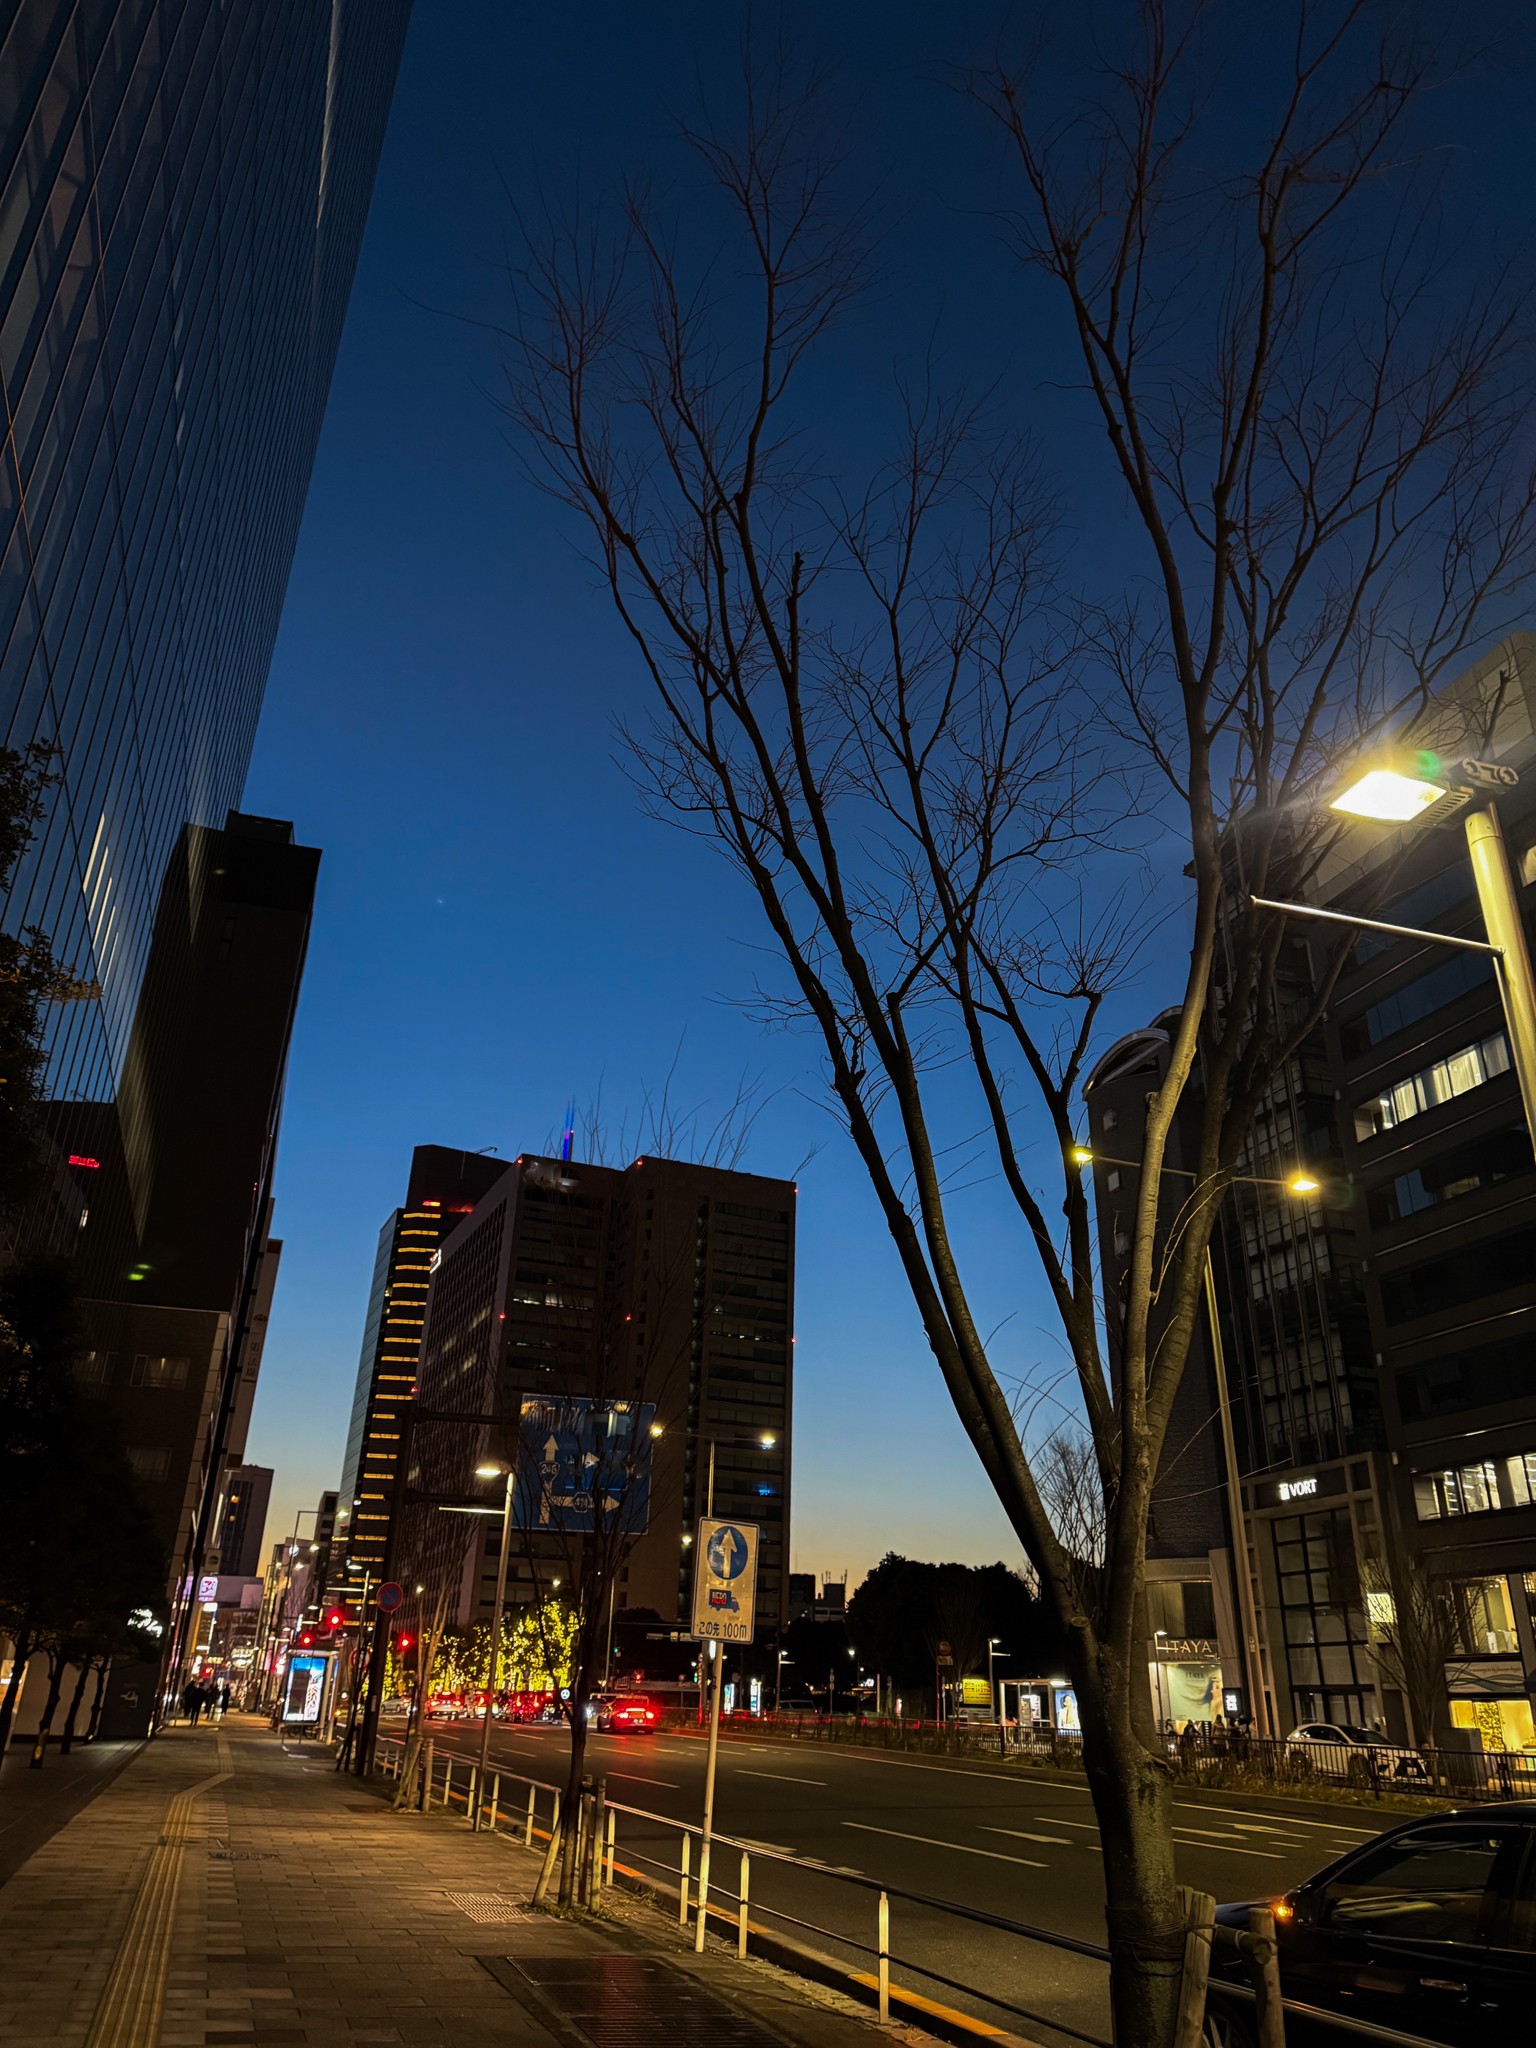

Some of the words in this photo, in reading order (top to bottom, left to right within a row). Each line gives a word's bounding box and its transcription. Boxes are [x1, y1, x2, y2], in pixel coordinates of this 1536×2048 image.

[541, 1463, 557, 1475] 246
[1289, 1478, 1317, 1497] VORT
[698, 1621, 720, 1637] この先
[723, 1623, 747, 1638] 100m
